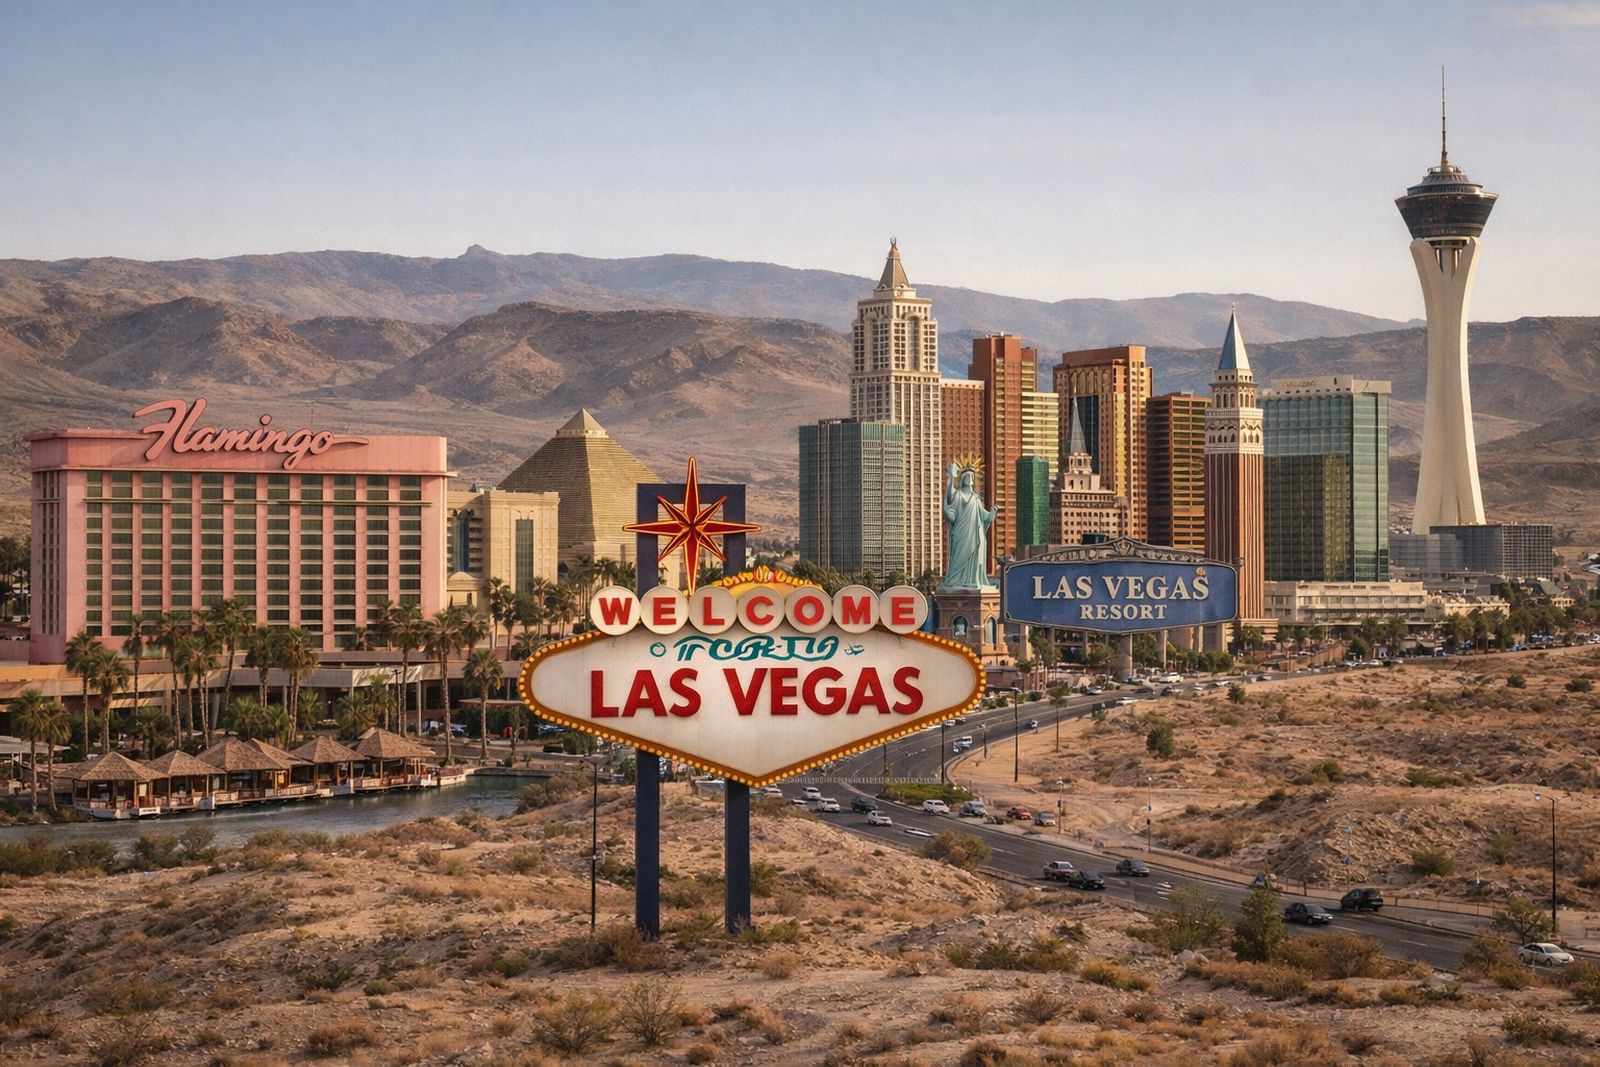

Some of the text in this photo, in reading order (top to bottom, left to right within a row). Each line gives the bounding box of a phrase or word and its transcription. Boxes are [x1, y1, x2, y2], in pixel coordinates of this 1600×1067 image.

[132, 398, 369, 470] Flamingo
[1032, 575, 1209, 600] LAS VEGAS
[598, 596, 915, 625] WELCOME
[1079, 604, 1168, 620] RESORT
[590, 667, 924, 718] LAS VEGAS
